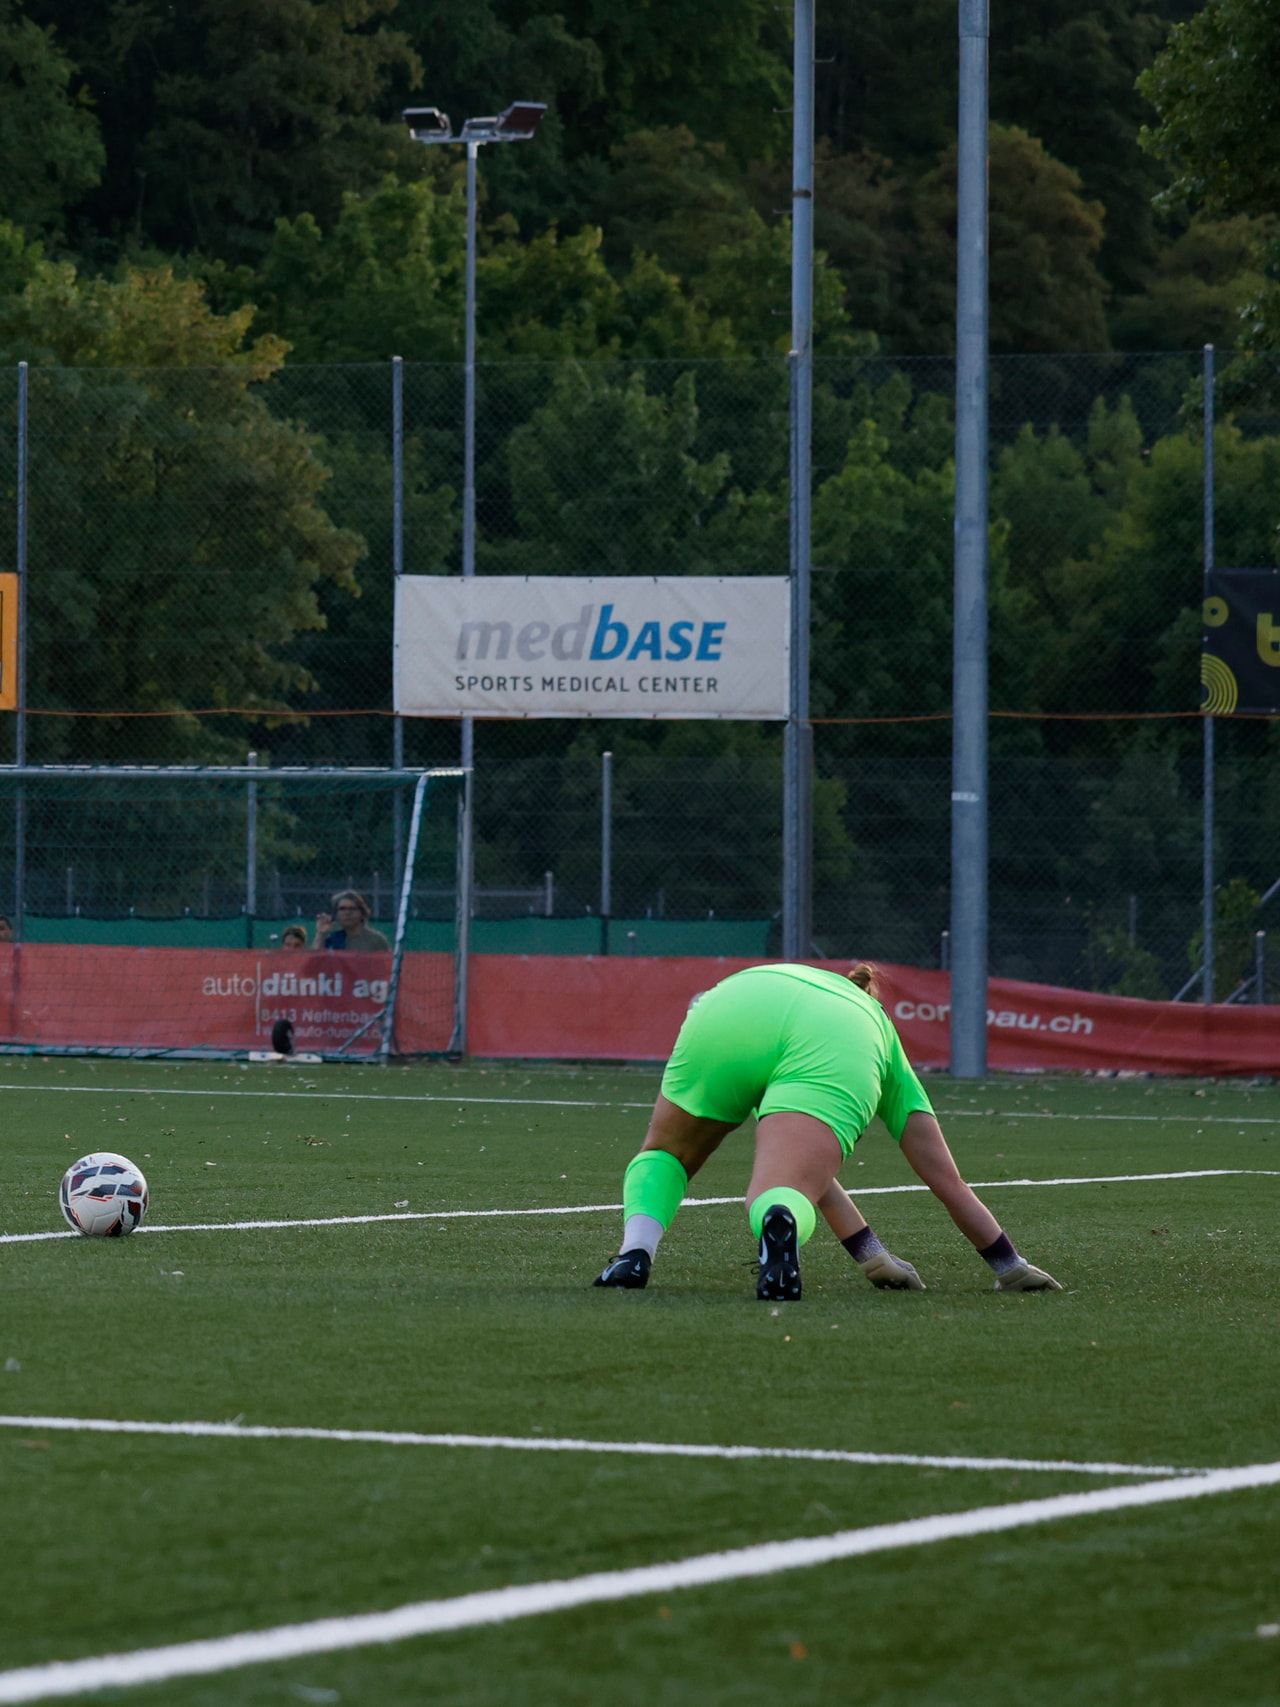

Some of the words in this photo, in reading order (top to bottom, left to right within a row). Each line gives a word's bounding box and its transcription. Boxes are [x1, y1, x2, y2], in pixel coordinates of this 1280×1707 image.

[455, 675, 533, 692] SPORTS
[542, 676, 630, 692] MEDICAL
[638, 676, 718, 693] CENTER
[202, 975, 256, 996] auto
[352, 979, 389, 1003] ag
